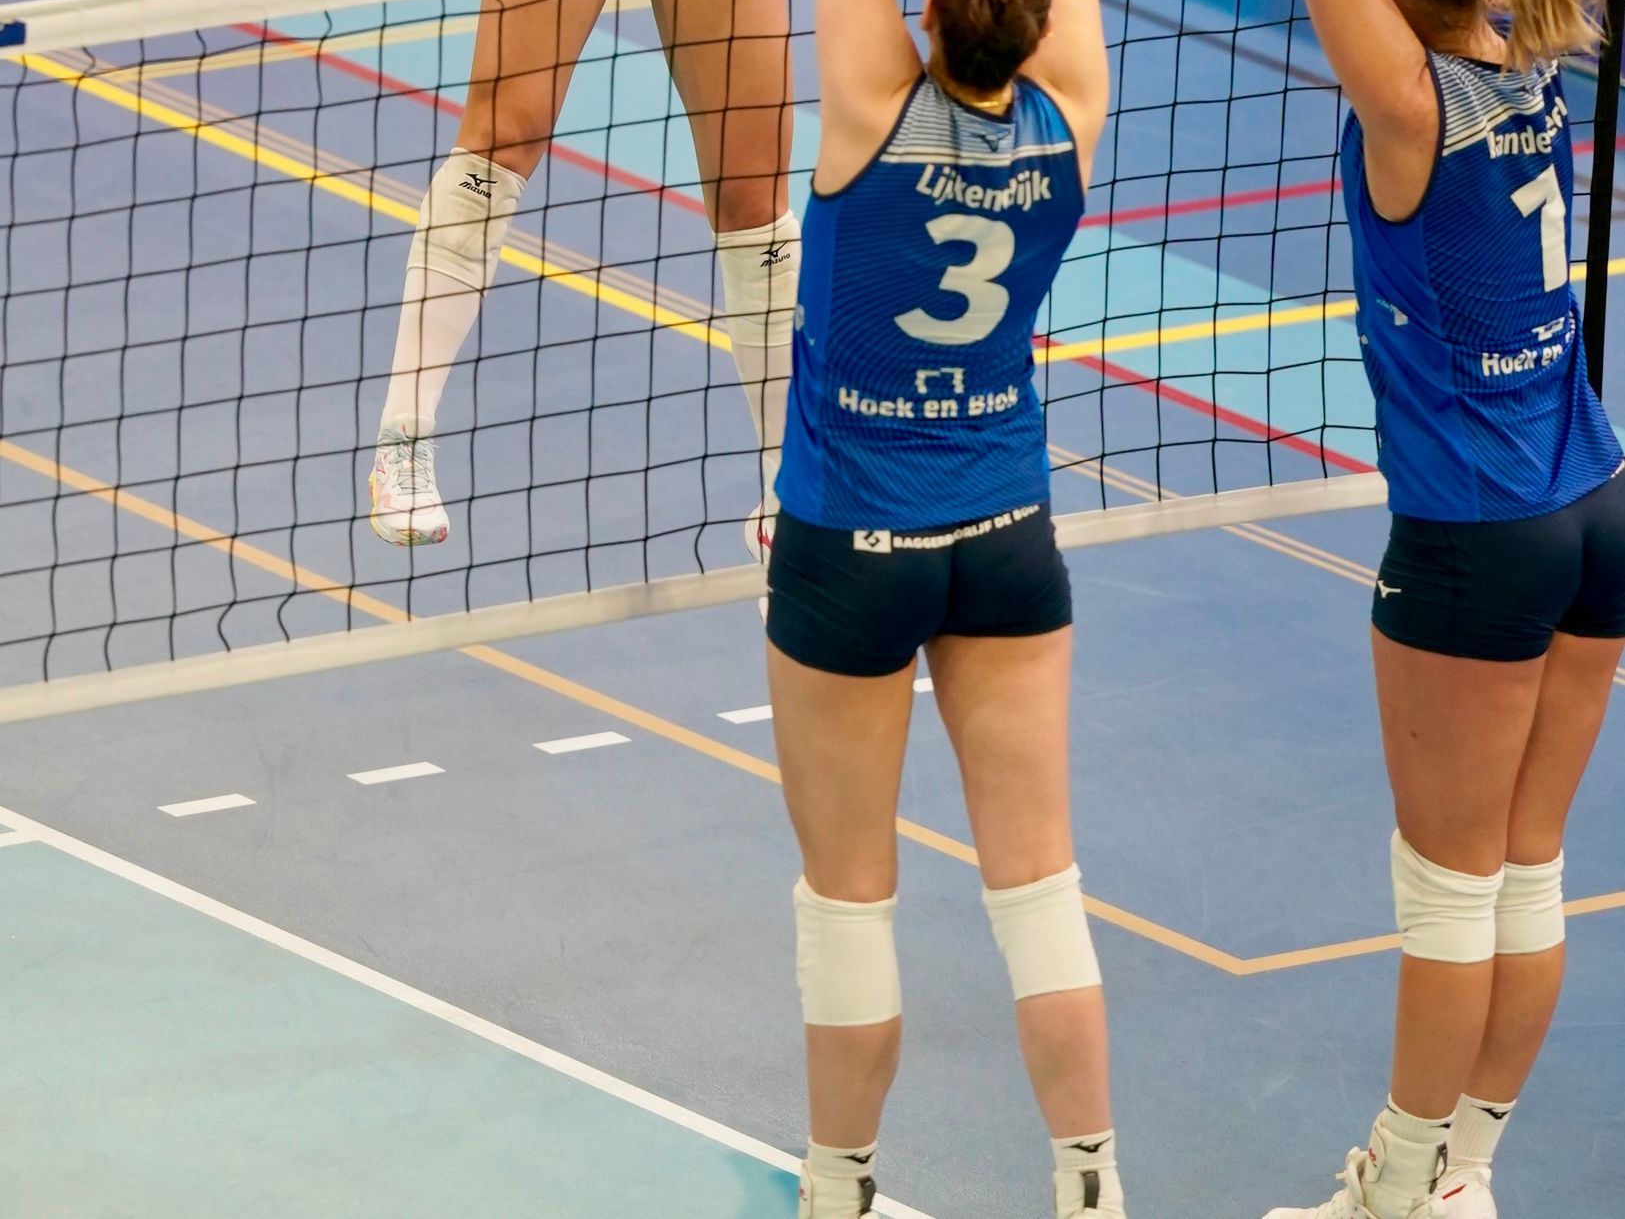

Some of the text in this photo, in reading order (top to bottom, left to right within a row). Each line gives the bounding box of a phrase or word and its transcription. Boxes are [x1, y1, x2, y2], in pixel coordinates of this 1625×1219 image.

[915, 163, 1051, 212] Lijkendijk
[893, 212, 1016, 347] 3
[1481, 348, 1538, 378] Hoek
[838, 385, 1019, 419] Hoek en Blok
